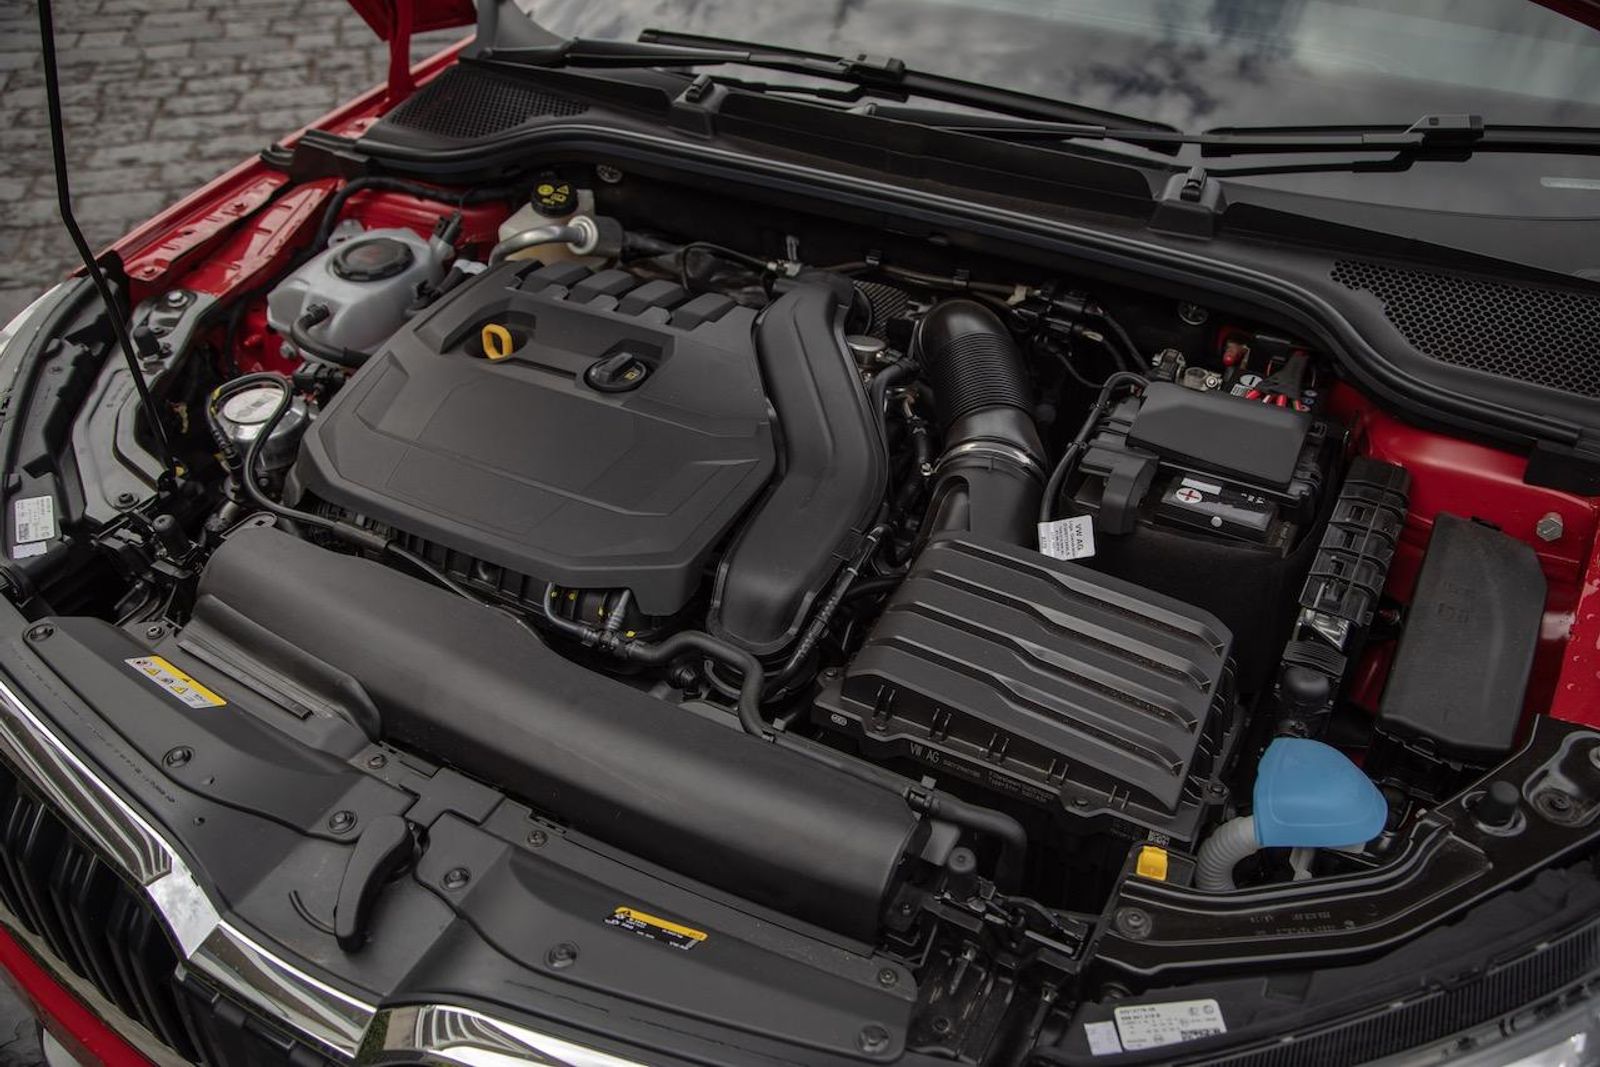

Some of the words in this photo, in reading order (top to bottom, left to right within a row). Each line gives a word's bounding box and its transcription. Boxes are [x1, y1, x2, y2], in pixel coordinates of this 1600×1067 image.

[1075, 523, 1083, 537] VW
[1076, 538, 1084, 551] AG
[910, 742, 922, 757] VW
[926, 749, 940, 764] AG
